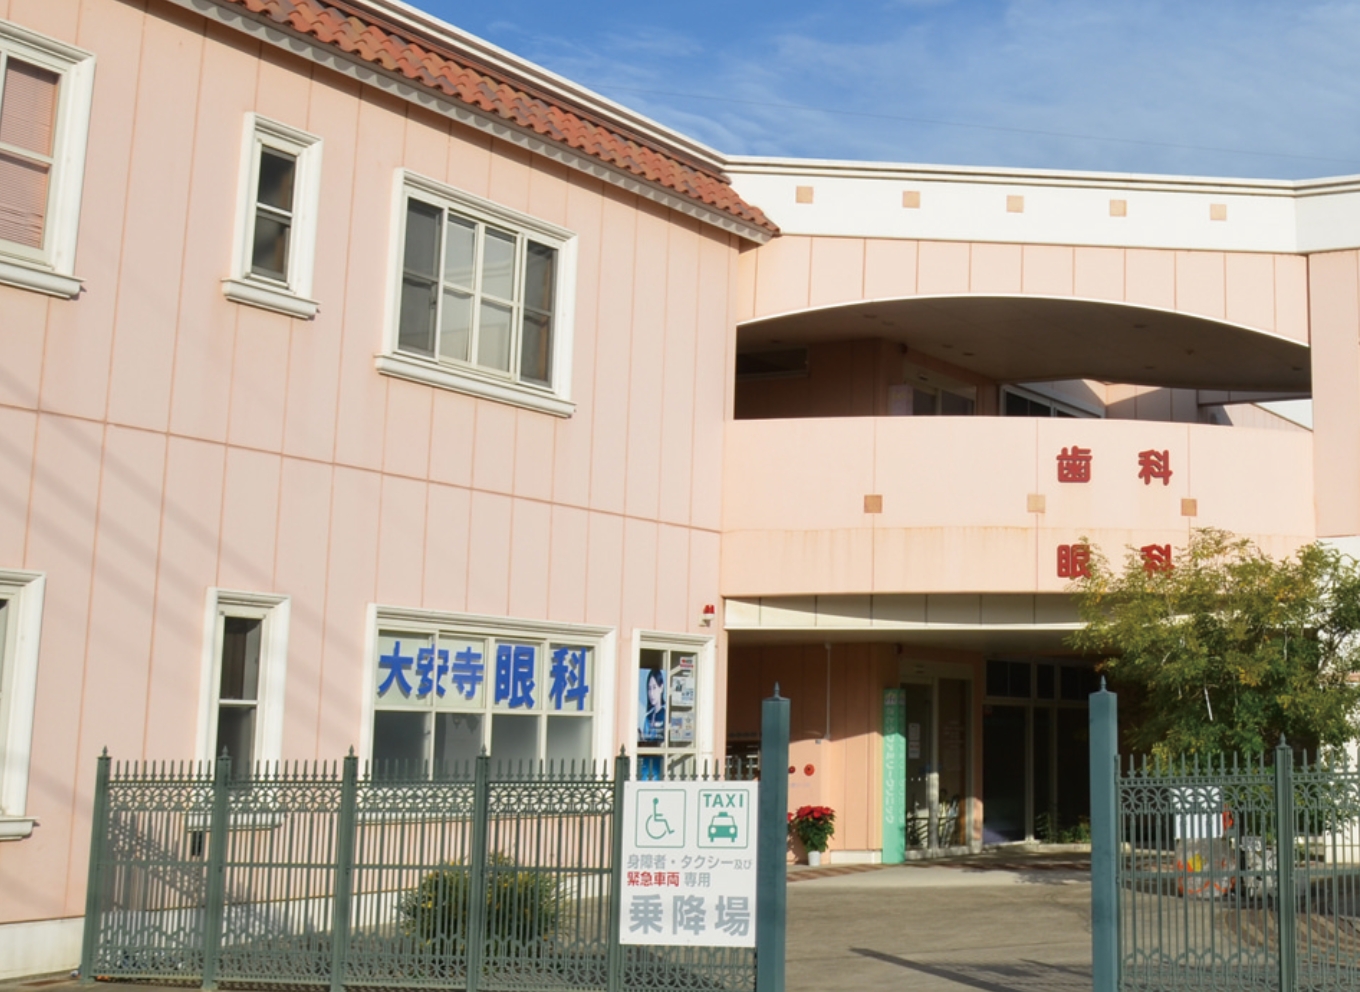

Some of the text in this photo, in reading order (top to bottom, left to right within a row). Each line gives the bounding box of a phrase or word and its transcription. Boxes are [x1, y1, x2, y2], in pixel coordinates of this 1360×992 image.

[1056, 446, 1173, 486] 歯科
[703, 793, 744, 808] TAXI
[627, 871, 711, 888] 緊急車両 専用
[628, 893, 752, 937] 乗降場
